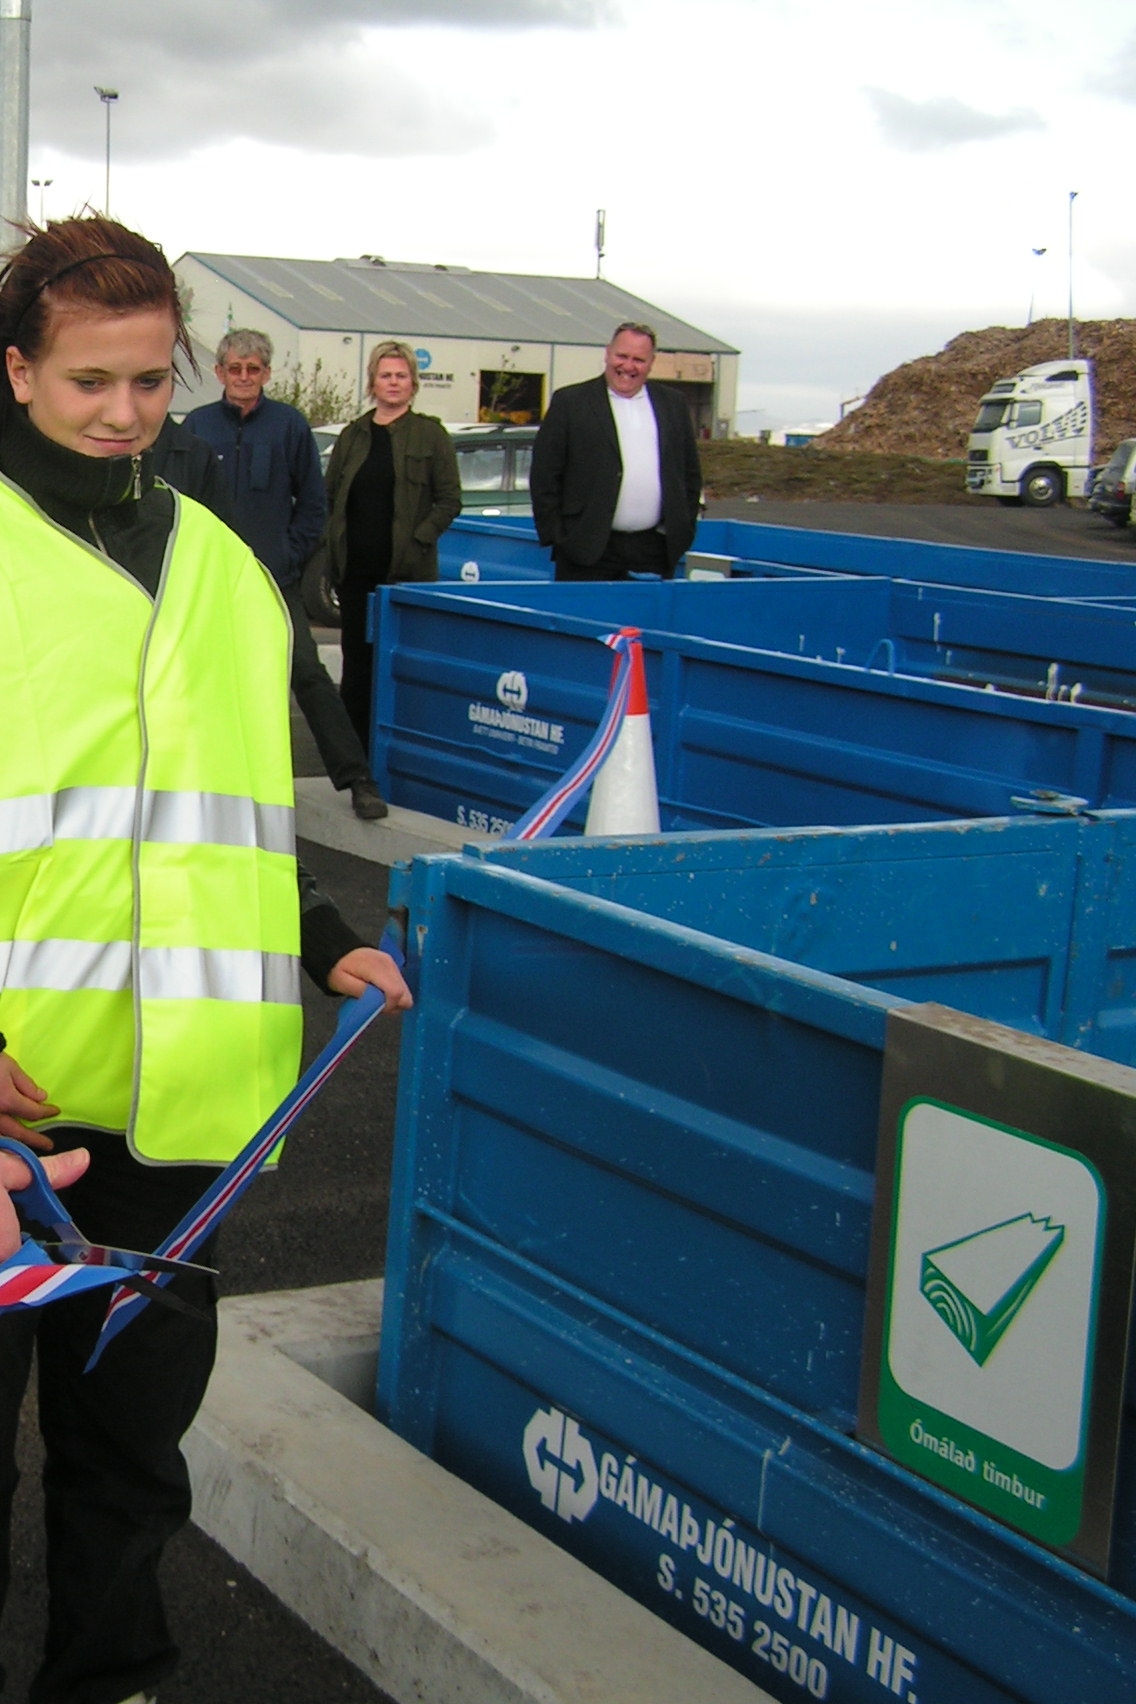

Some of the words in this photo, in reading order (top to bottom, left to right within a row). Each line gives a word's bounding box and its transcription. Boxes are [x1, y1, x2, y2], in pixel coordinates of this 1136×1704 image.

[909, 1418, 976, 1472] Ómálað
[982, 1460, 1046, 1509] timbur
[599, 1451, 860, 1665] GÁMAÞJÓNUSTAN
[657, 1553, 683, 1600] S.
[693, 1577, 746, 1641] 535
[751, 1620, 829, 1700] 2500
